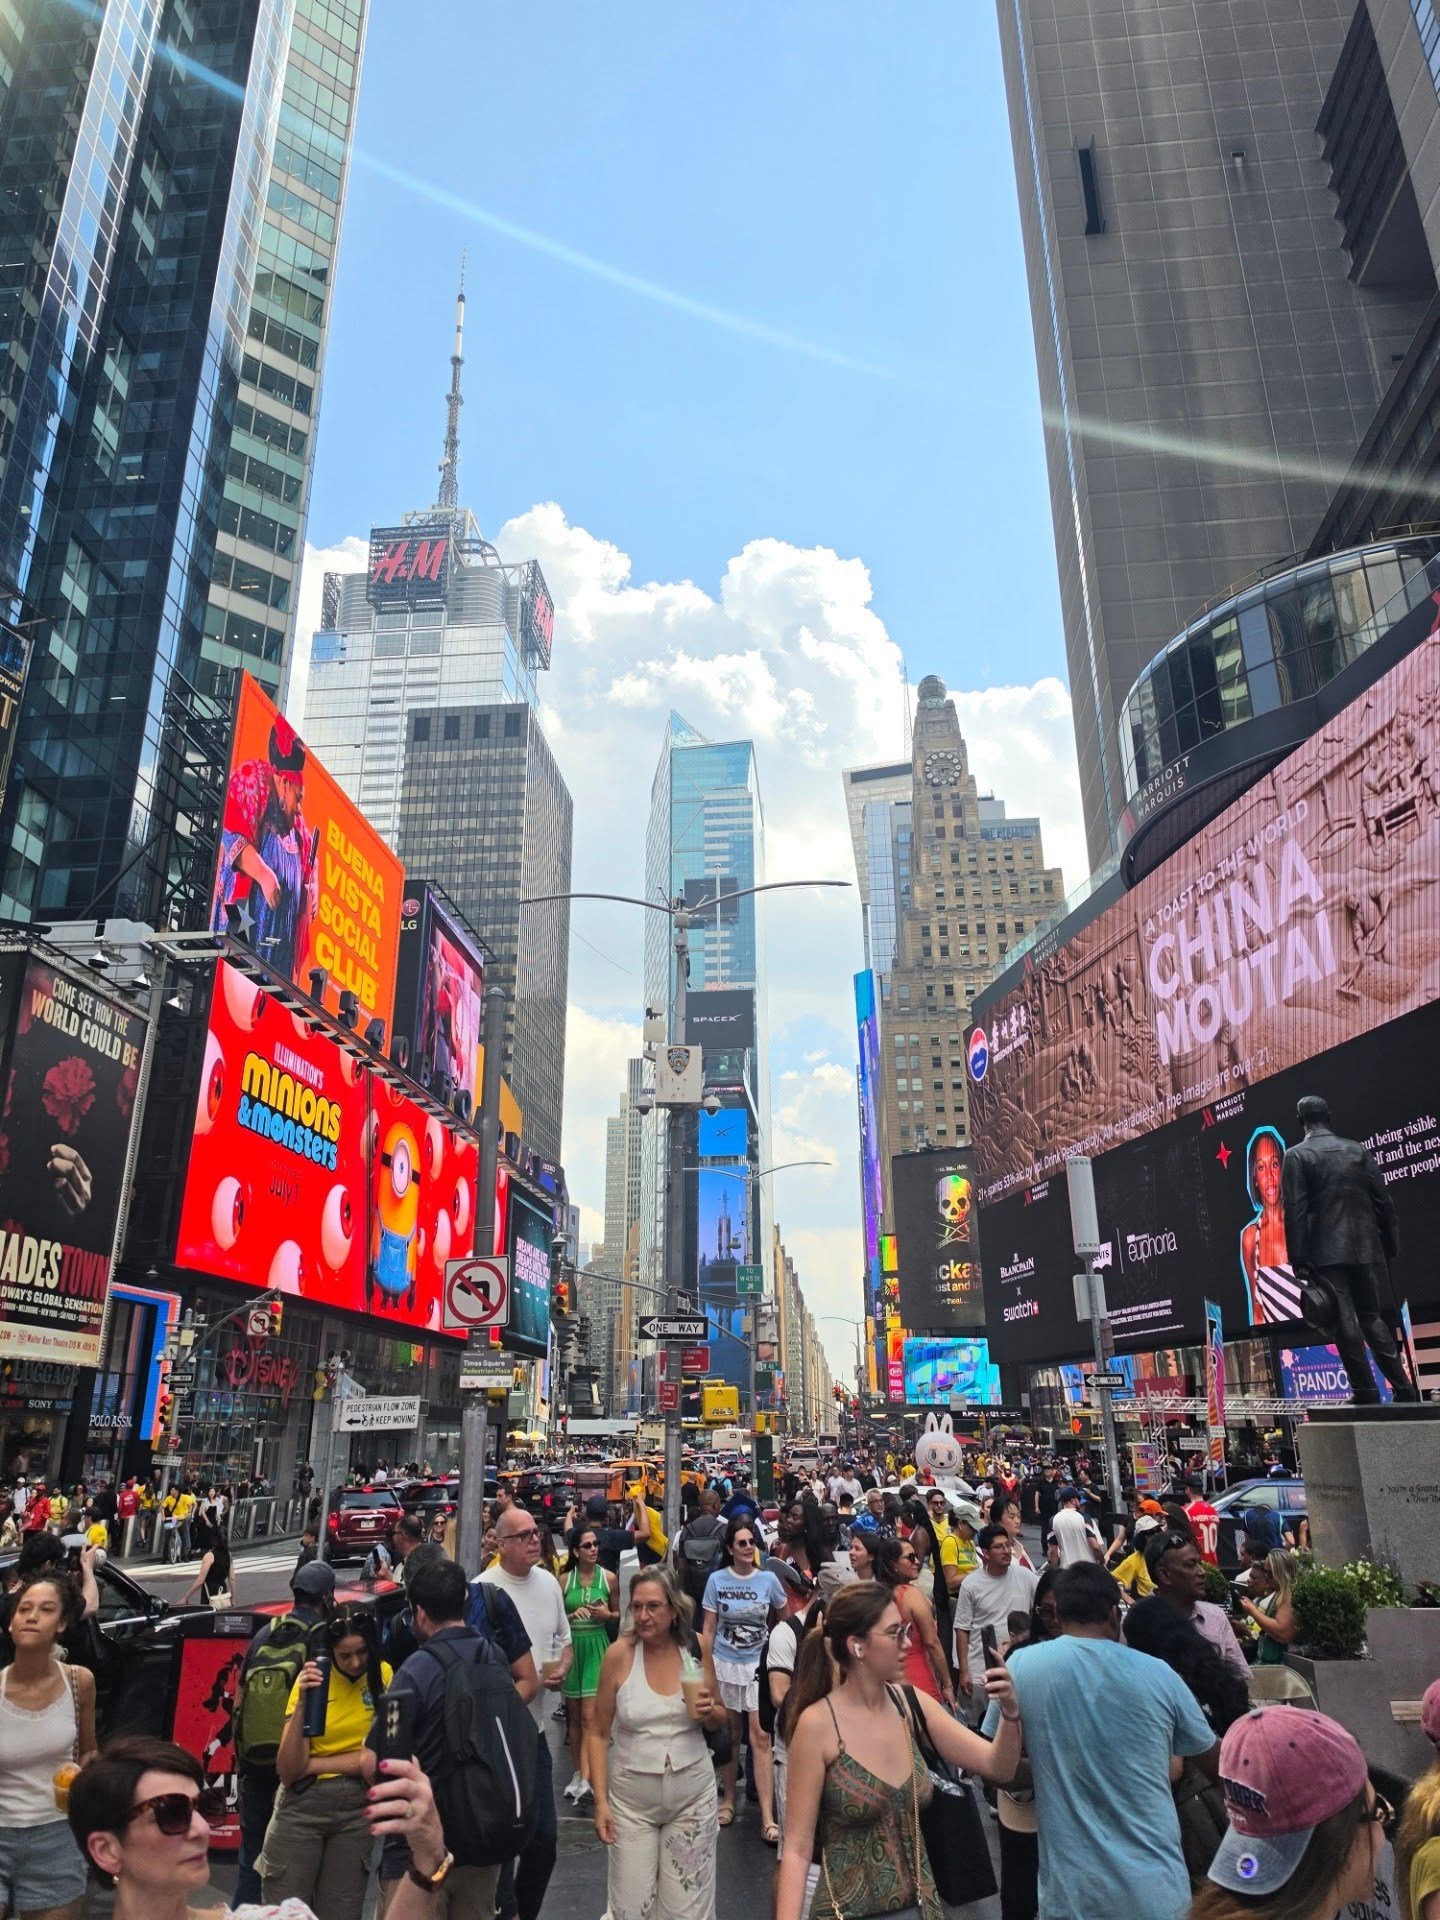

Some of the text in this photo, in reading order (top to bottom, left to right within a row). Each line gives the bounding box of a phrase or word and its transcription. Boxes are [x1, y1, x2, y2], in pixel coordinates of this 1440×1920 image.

[371, 540, 448, 584] H&M
[1137, 756, 1190, 805] MARRIOTT
[1138, 776, 1184, 820] MARQUIS
[327, 817, 385, 904] BUENA
[1145, 800, 1308, 936] A TOAST TO THE WORLD
[323, 851, 382, 940] VISTA
[319, 893, 380, 973] SOCIAL
[401, 920, 418, 930] LG
[1150, 838, 1325, 999] CHINA
[315, 932, 379, 1011] CLUB
[1156, 910, 1336, 1066] MOUTAI
[52, 977, 129, 1036] COME SEE HOW THE
[693, 1014, 743, 1023] SPACEX
[31, 988, 139, 1070] WORLD COULD BE
[274, 1042, 324, 1089] ILLUMINATION'S
[1044, 1150, 1062, 1169] Drink
[1114, 1106, 1155, 1134] characters
[1166, 1093, 1182, 1109] the
[1183, 1079, 1213, 1102] image
[1213, 1070, 1231, 1086] are
[1232, 1059, 1255, 1079] over
[1215, 1092, 1246, 1111] MARRIOTT
[1217, 1104, 1244, 1121] MARQUIS
[1375, 1128, 1403, 1147] being
[1403, 1115, 1437, 1137] visible
[1386, 1144, 1404, 1165] and
[1405, 1141, 1422, 1157] the
[269, 1174, 293, 1206] July
[1128, 1228, 1178, 1264] euphoria
[33, 1291, 63, 1308] GLOBAL
[64, 1297, 105, 1315] SENSATION
[1003, 1299, 1033, 1322] swatch
[649, 1323, 699, 1333] ONE WAY
[463, 1367, 511, 1375] Pedestrian Plaza
[482, 1360, 506, 1368] Square
[28, 1399, 53, 1409] SONY
[346, 1400, 417, 1413] PEDESTRIAN FLOW ZONE
[376, 1414, 416, 1425] KEEP MOVING
[89, 1414, 133, 1428] POLO ASSN.
[1199, 1522, 1218, 1554] 10
[718, 1591, 758, 1600] MONACO
